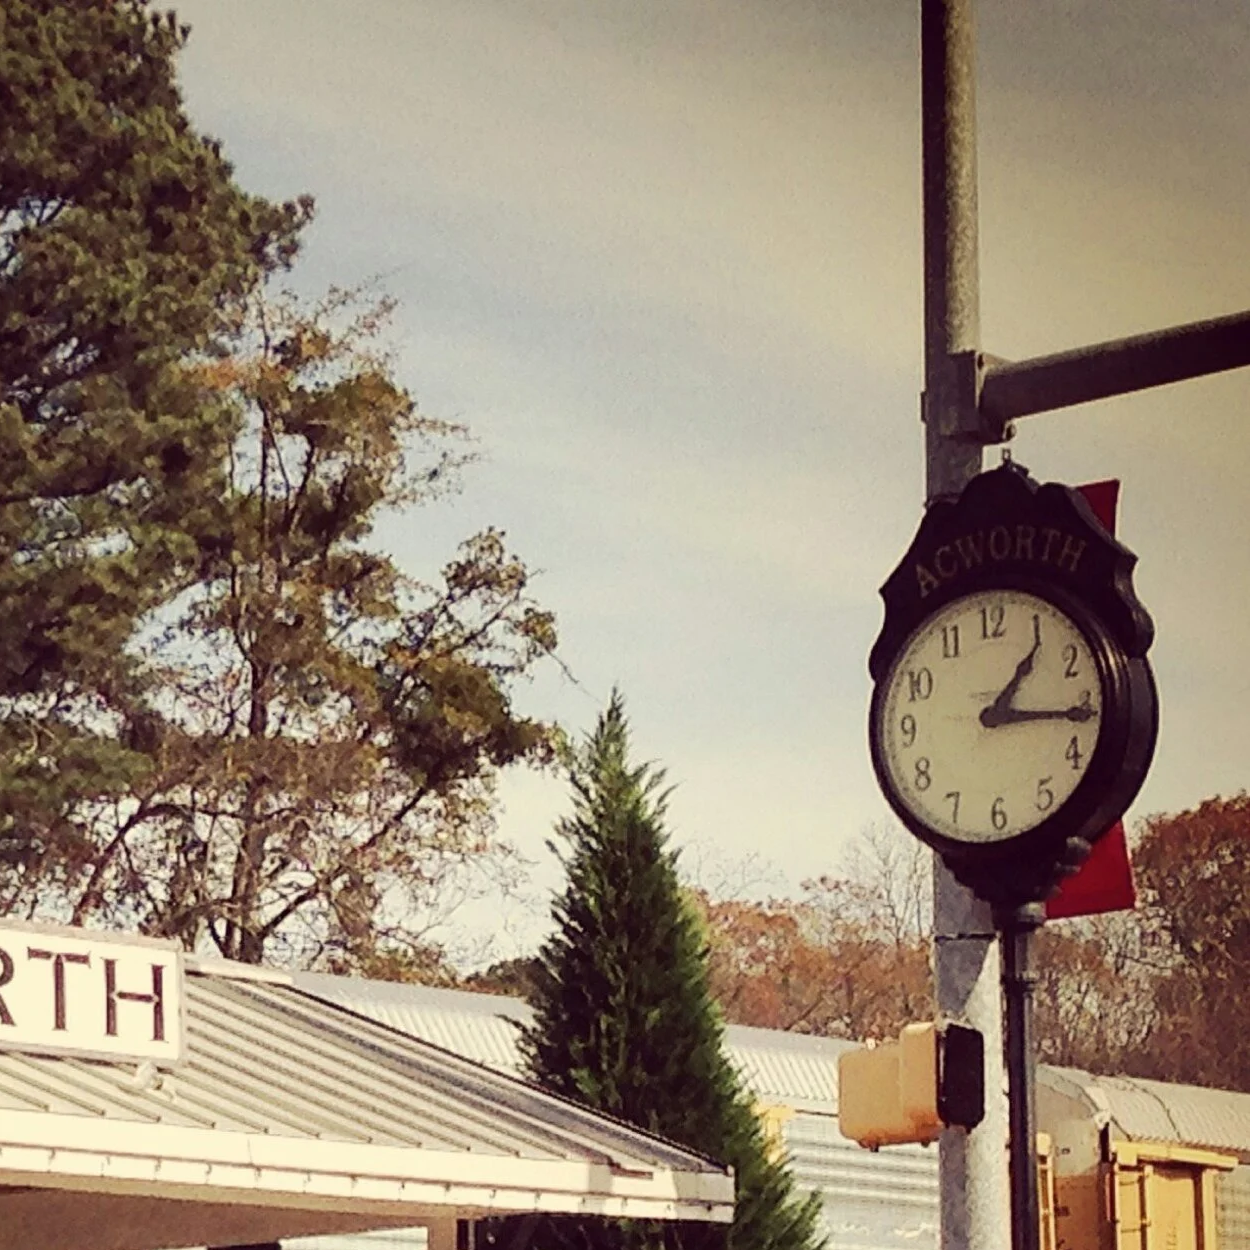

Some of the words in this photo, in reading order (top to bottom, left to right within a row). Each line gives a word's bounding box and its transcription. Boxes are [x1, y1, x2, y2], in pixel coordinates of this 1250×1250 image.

[915, 524, 1087, 599] ACWORTH
[979, 605, 1006, 640] 12
[941, 624, 960, 659] 11
[1062, 645, 1079, 679] 2
[907, 667, 934, 702] 10
[901, 714, 917, 748] 9
[1065, 735, 1084, 770] 4
[914, 756, 932, 791] 8
[945, 791, 961, 824] 7
[1036, 776, 1054, 812] 5
[990, 797, 1008, 830] 6
